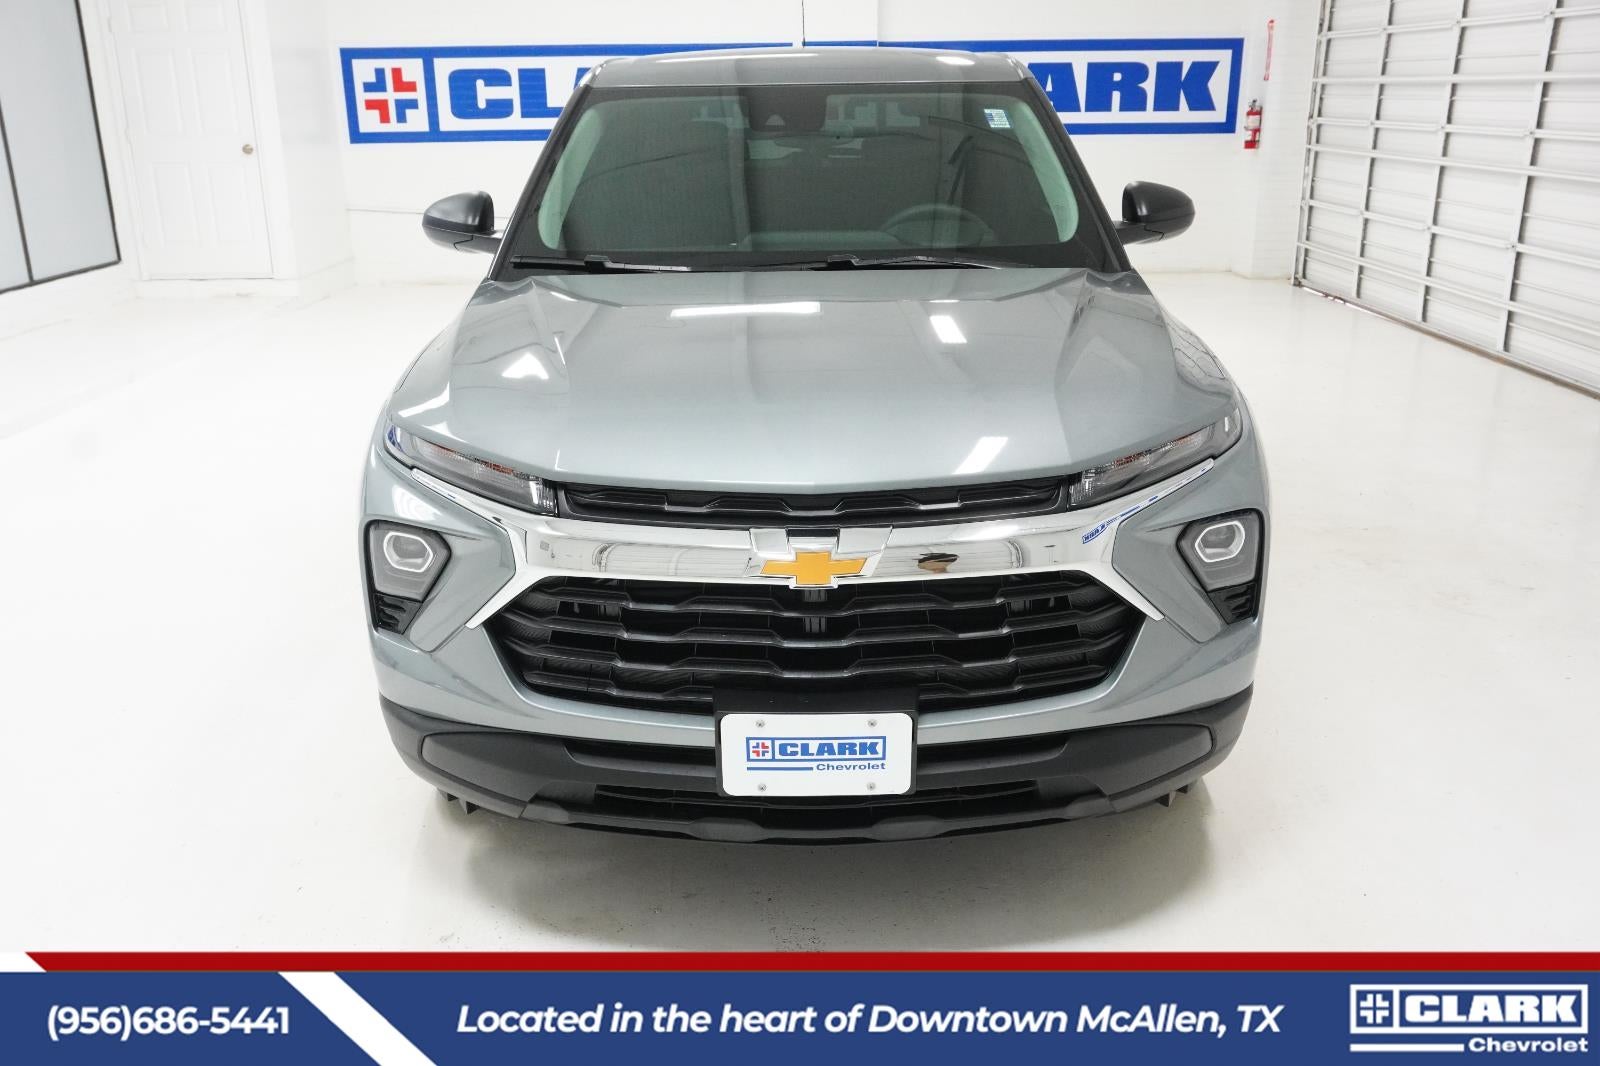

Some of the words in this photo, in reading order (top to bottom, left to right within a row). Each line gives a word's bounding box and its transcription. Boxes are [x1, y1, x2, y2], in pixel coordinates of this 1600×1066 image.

[1027, 60, 1220, 113] ARK
[778, 742, 879, 757] CLARK
[816, 762, 886, 771] Chevrolet
